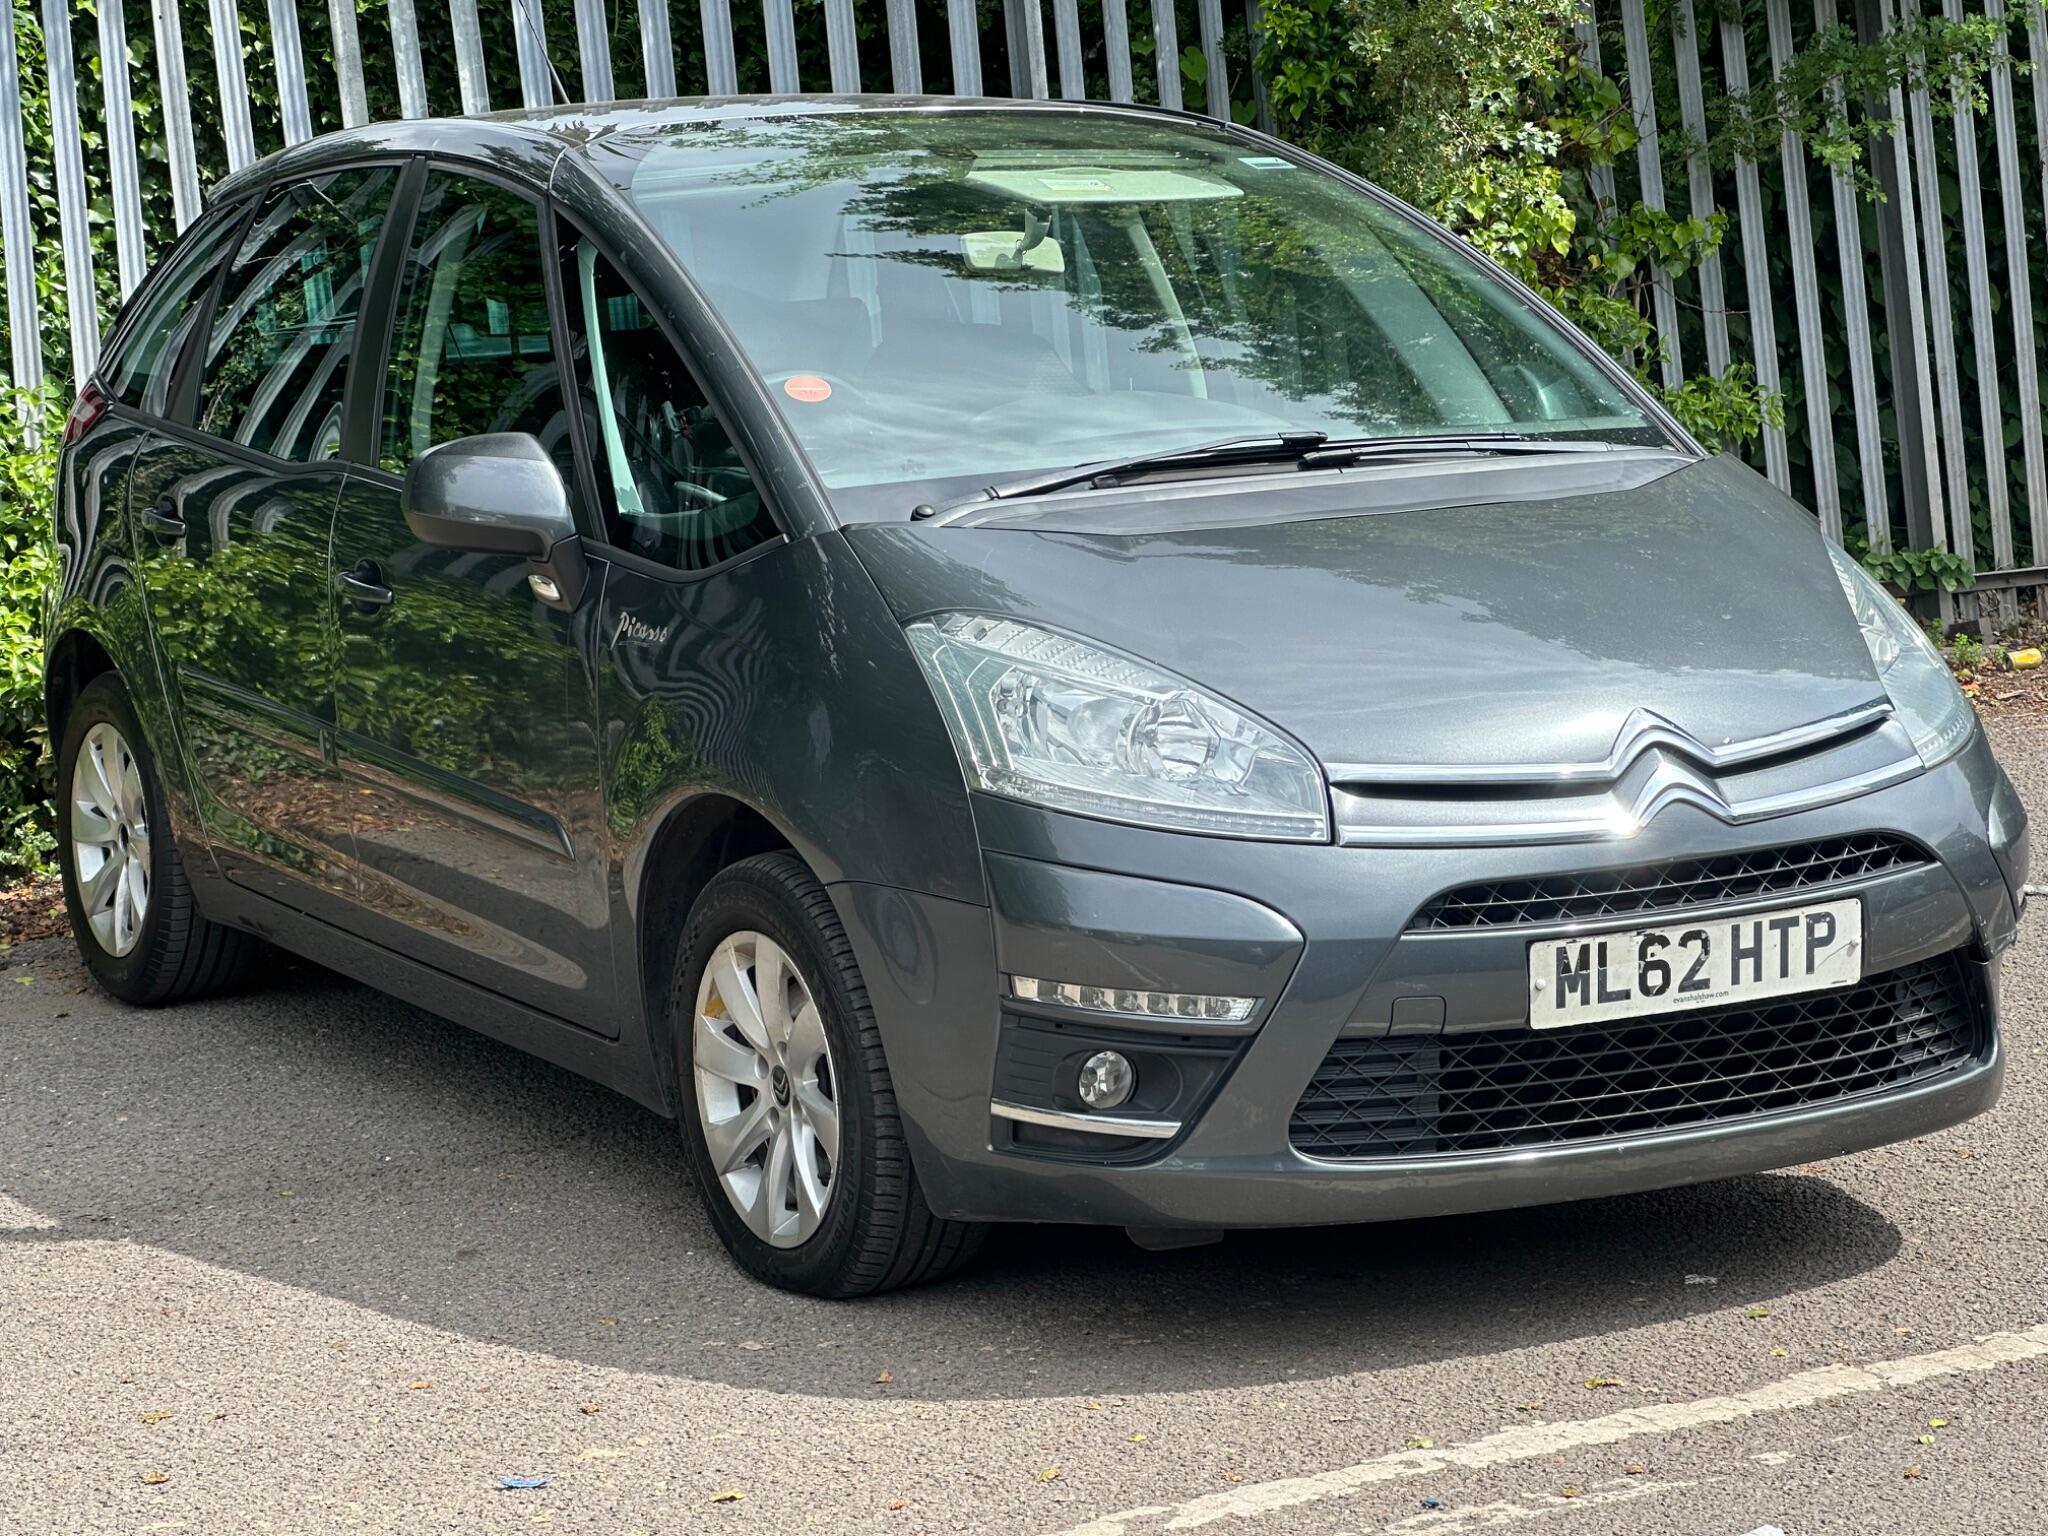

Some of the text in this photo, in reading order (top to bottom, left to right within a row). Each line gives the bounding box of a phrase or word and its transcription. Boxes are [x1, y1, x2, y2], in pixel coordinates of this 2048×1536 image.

[610, 611, 668, 651] Picasso
[1556, 911, 1837, 1009] ML62 HTP
